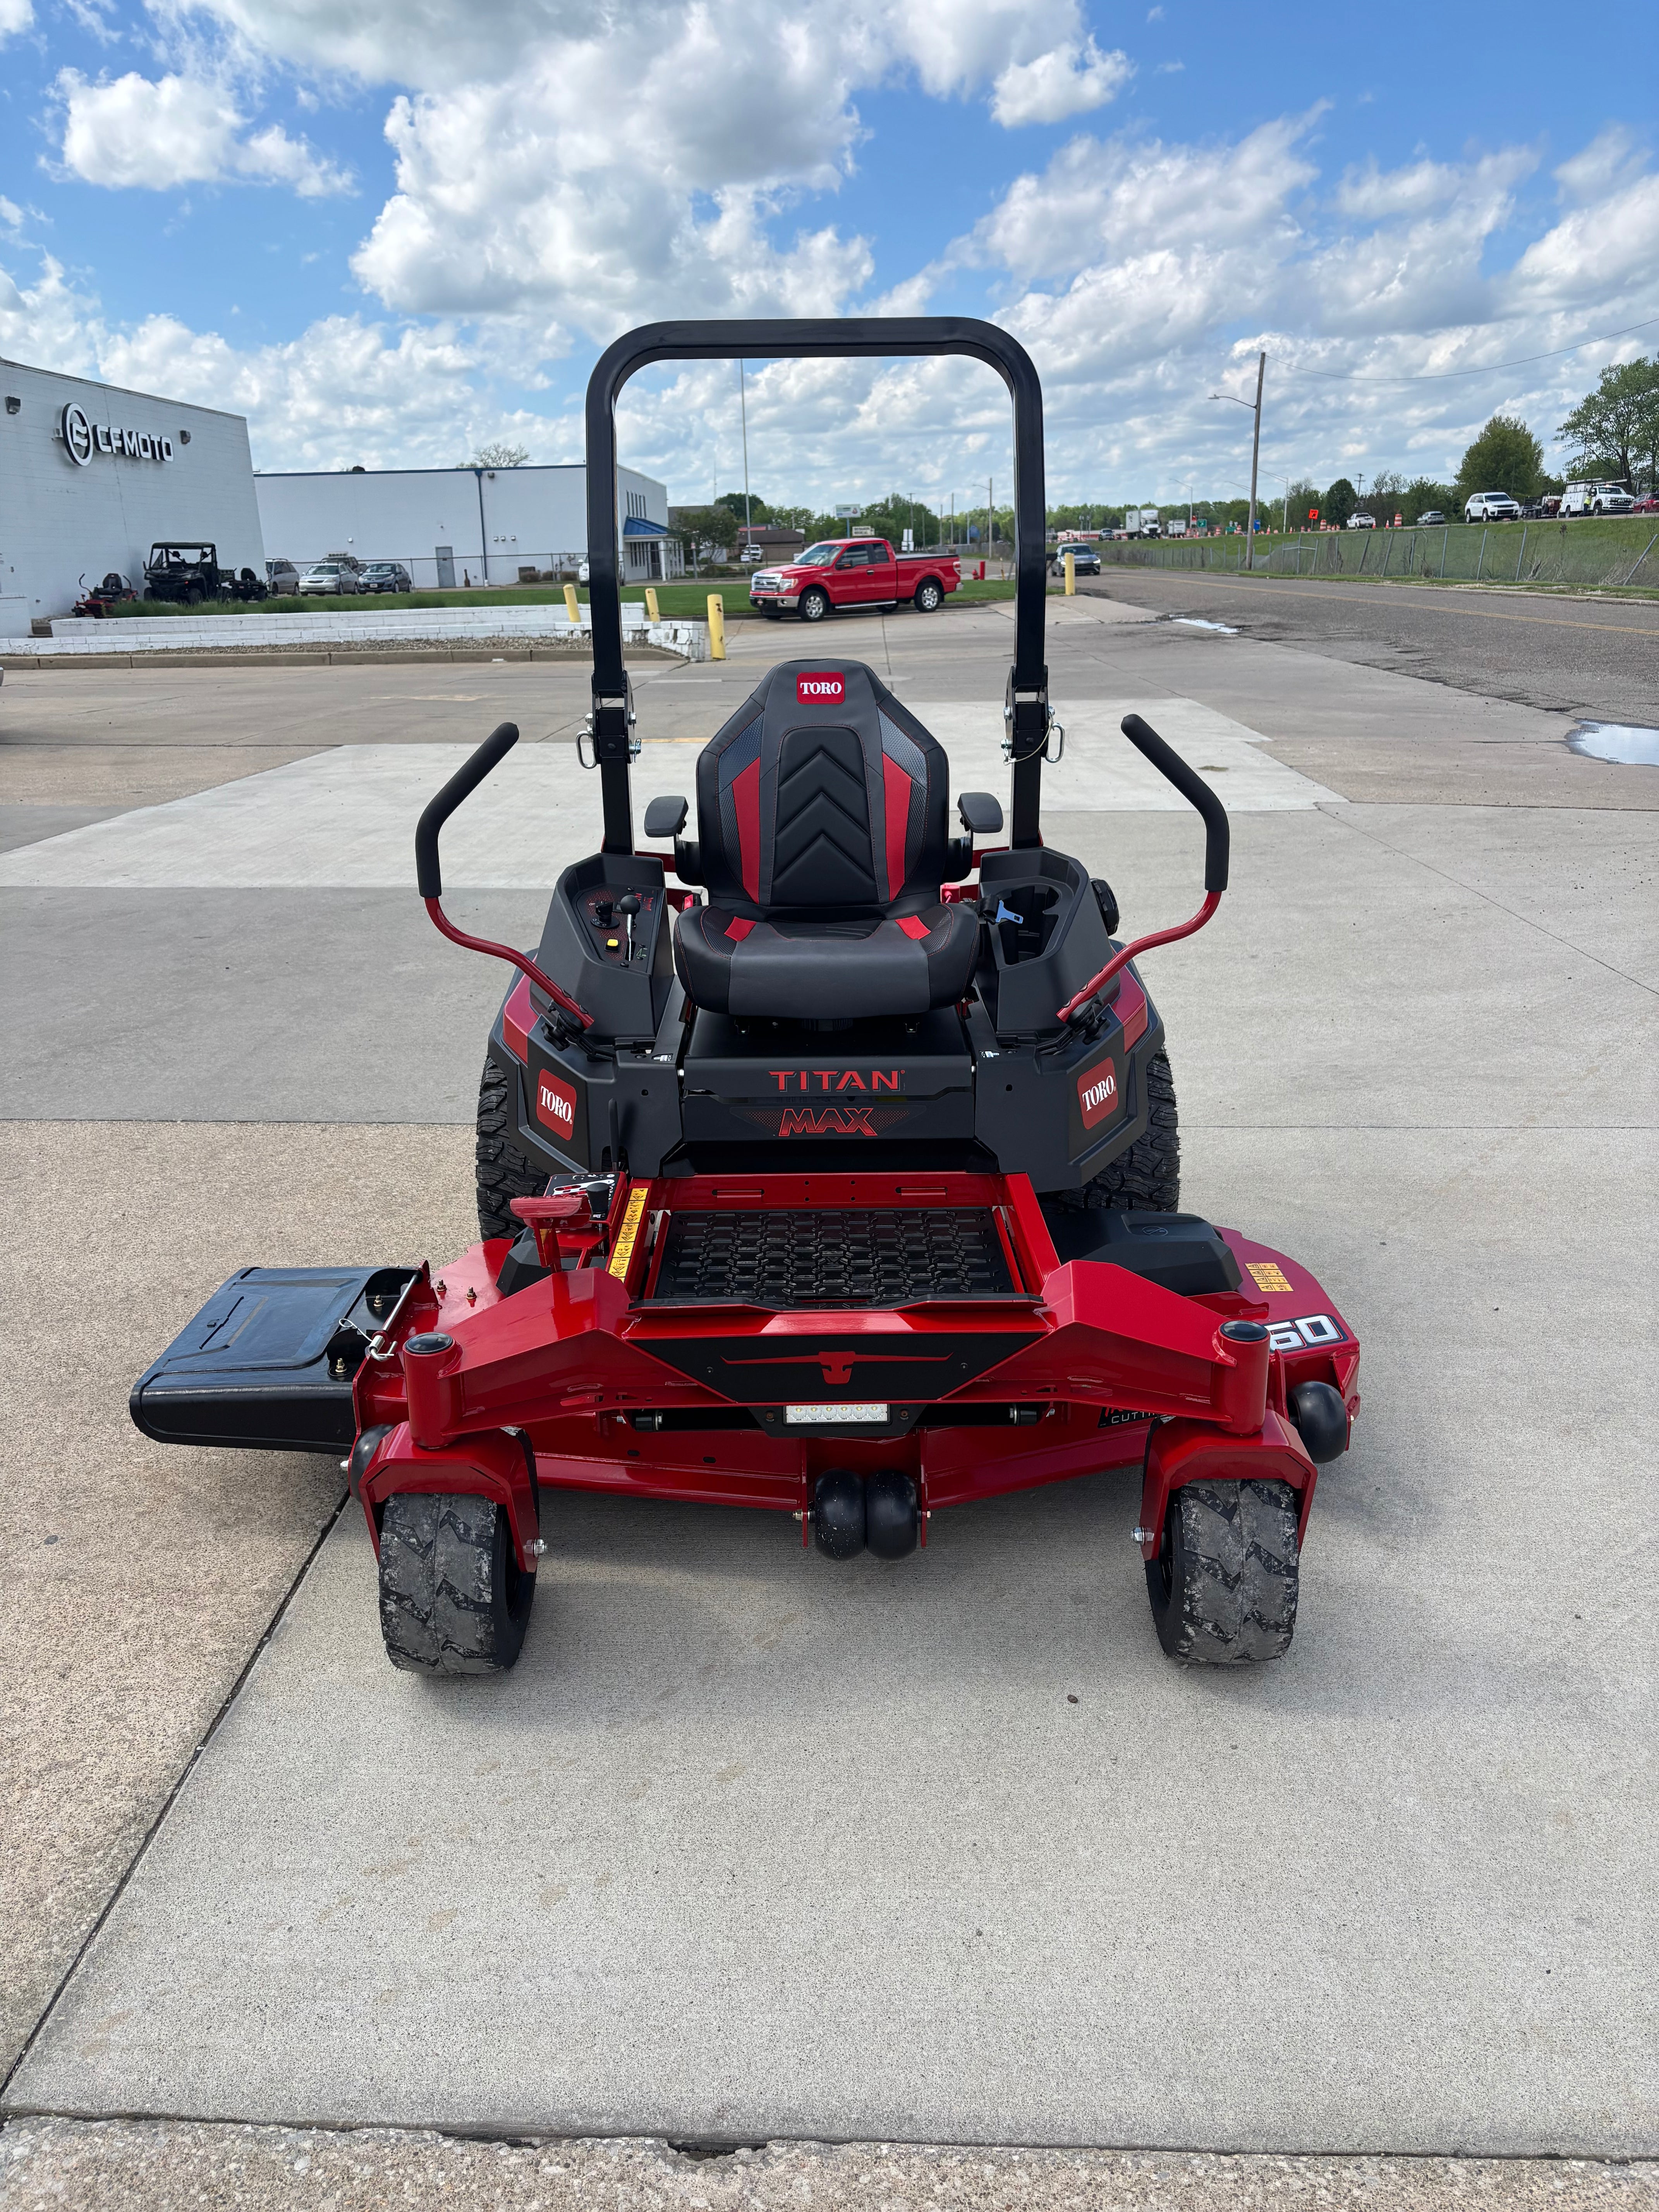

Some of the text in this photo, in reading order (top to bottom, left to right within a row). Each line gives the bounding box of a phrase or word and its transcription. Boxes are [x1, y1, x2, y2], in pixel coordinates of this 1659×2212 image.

[95, 424, 174, 461] CFMOTO
[800, 682, 842, 694] TORO
[768, 1071, 900, 1092] TITAN
[1082, 1075, 1114, 1111] TORO
[541, 1085, 572, 1122] TORO
[778, 1108, 878, 1136] MAX
[1264, 1315, 1341, 1351] 60
